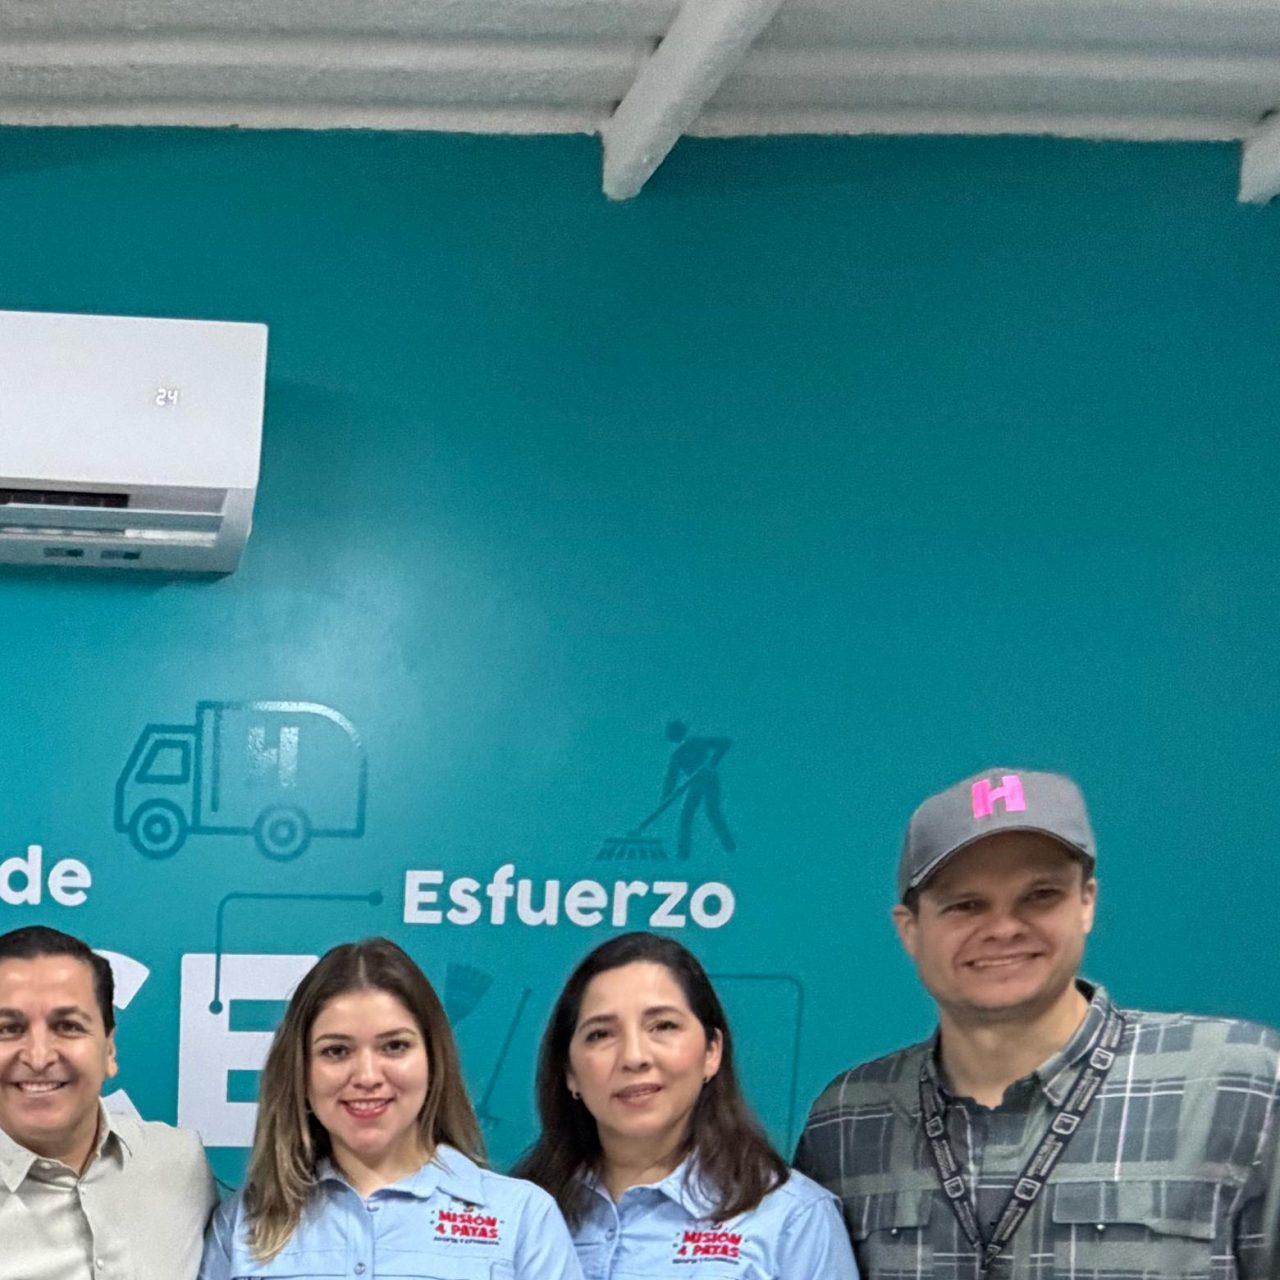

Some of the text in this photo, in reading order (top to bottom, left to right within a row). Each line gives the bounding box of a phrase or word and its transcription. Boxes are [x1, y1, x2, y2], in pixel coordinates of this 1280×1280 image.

[155, 388, 178, 406] 24
[971, 774, 1026, 820] H
[403, 863, 736, 929] Esfuerzo
[451, 1224, 499, 1240] PATAS
[691, 1244, 740, 1259] PATAS
